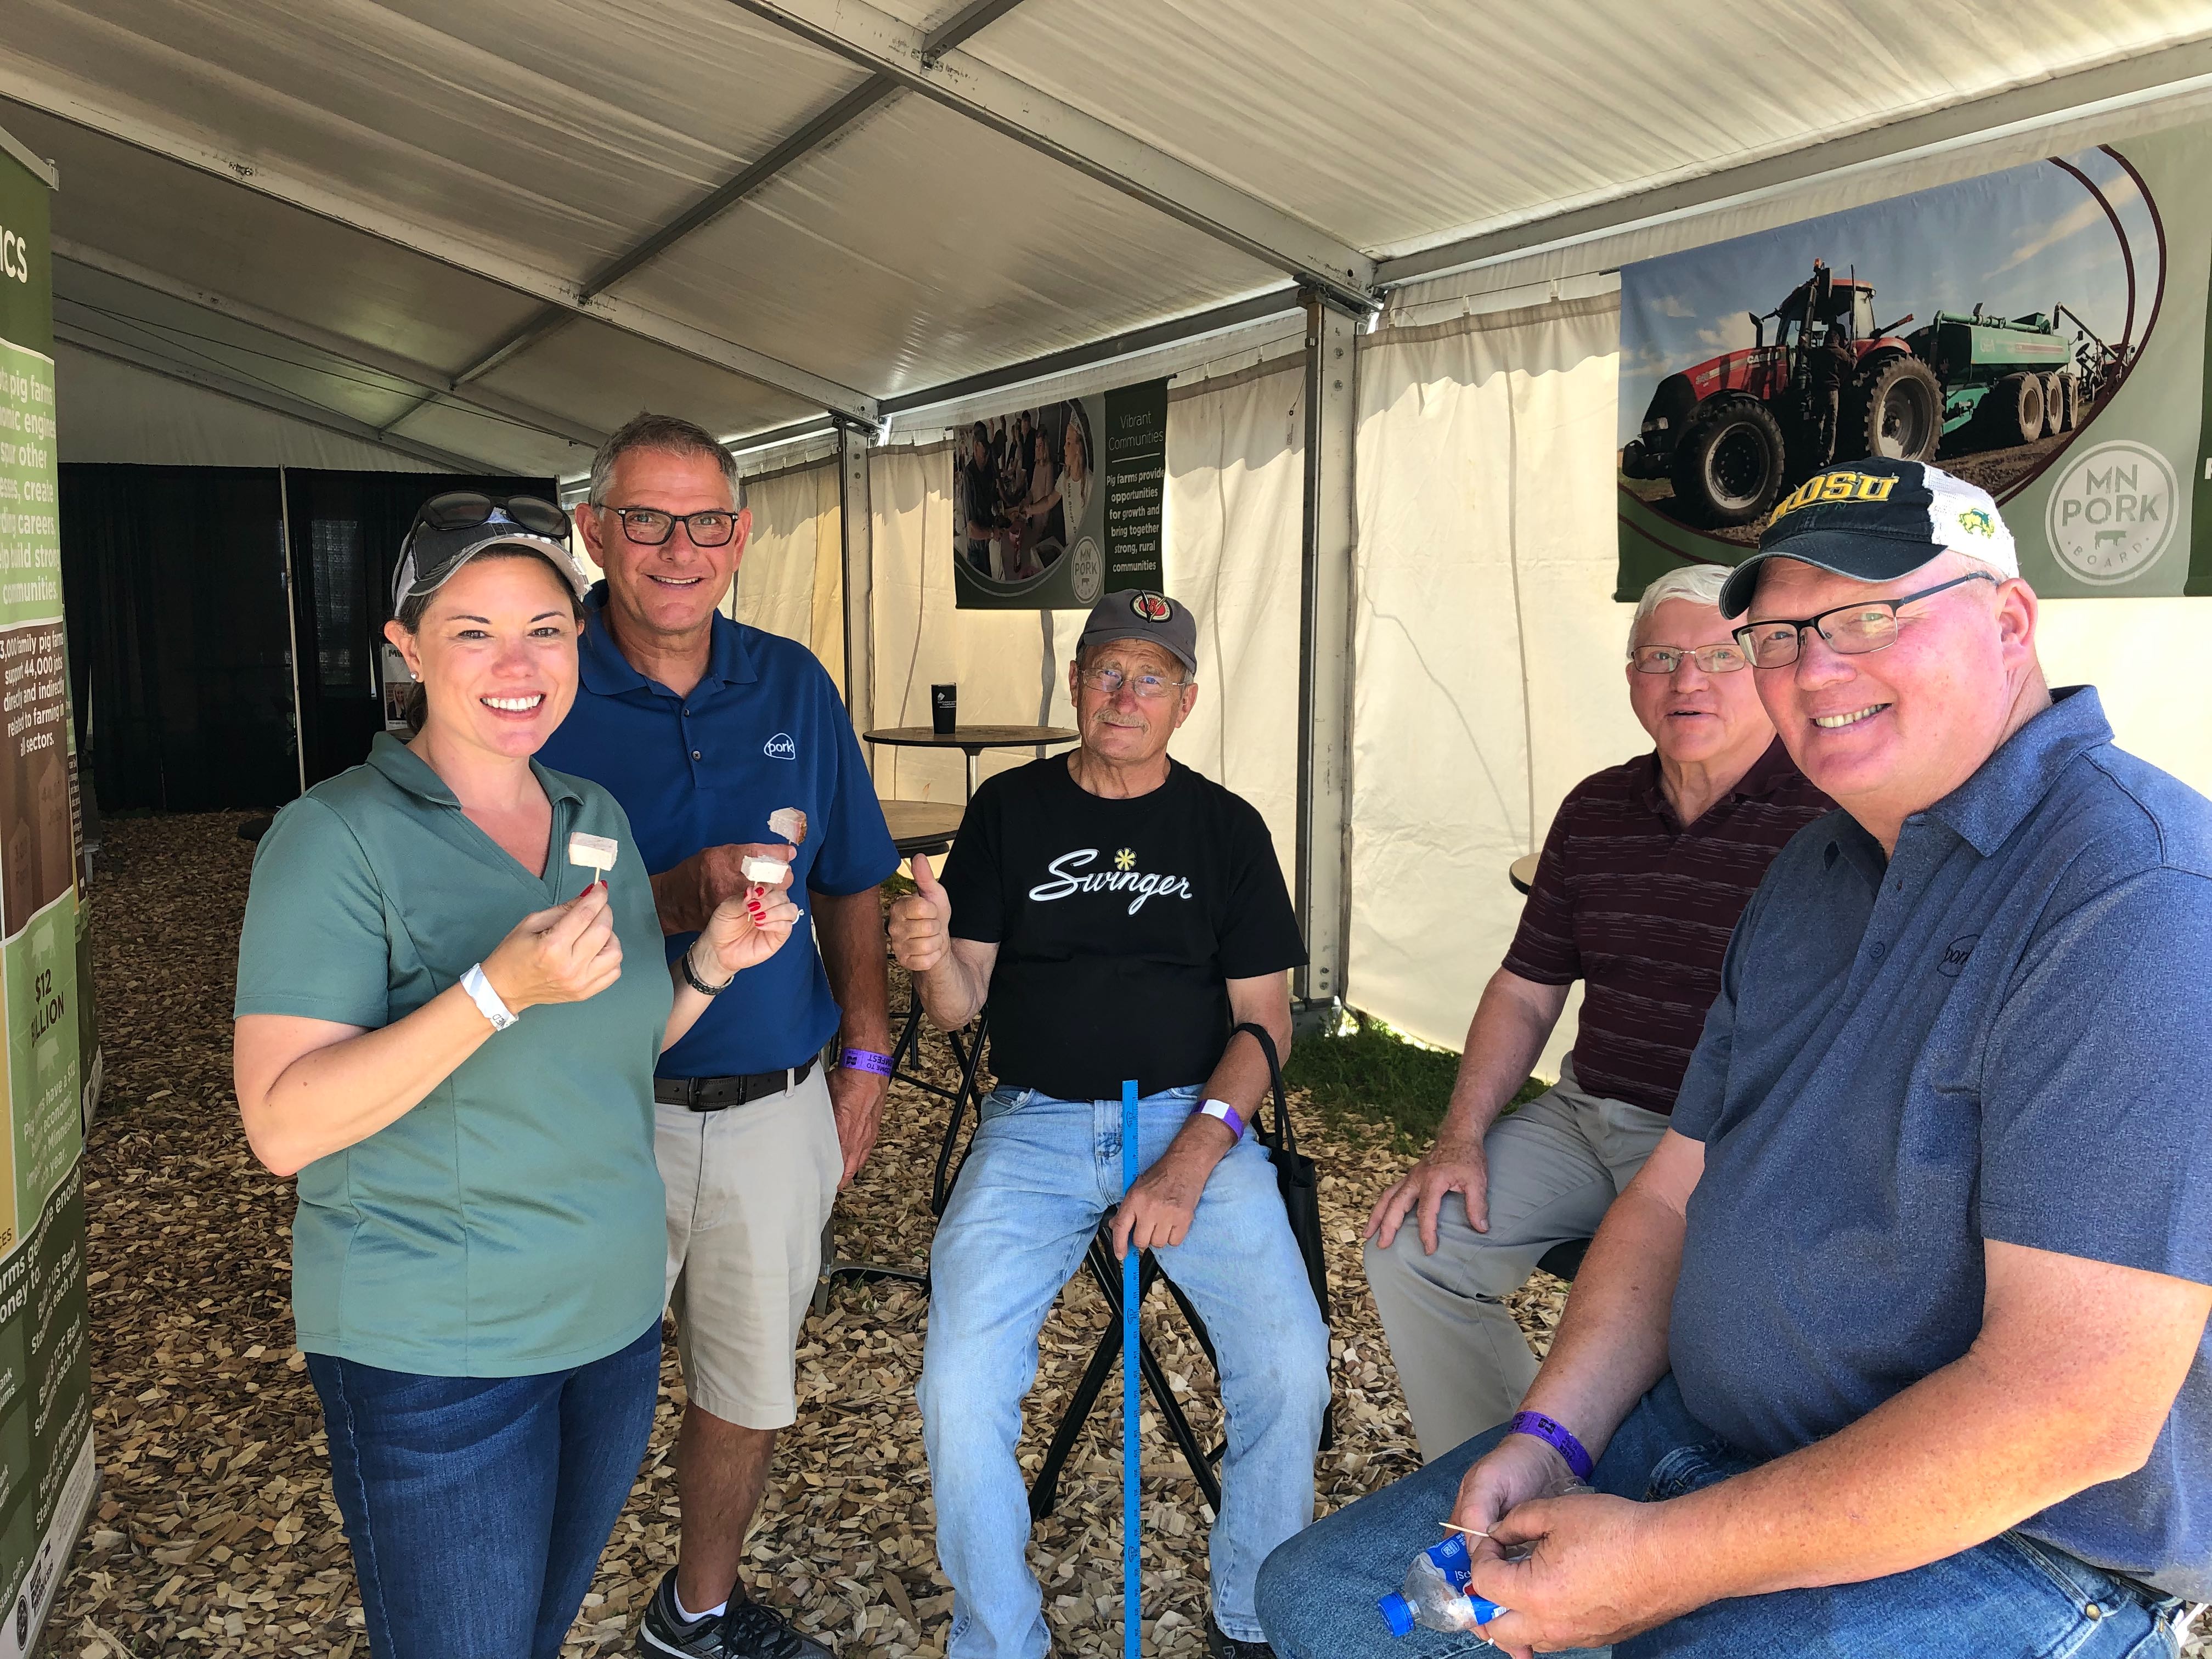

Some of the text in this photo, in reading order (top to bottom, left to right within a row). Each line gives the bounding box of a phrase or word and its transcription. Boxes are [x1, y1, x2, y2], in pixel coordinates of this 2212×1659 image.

[10, 370, 27, 403] pig
[30, 375, 53, 405] farms
[1120, 410, 1152, 429] Vibrant
[1108, 429, 1164, 450] Communities
[19, 442, 47, 469] other
[24, 481, 53, 503] create
[1107, 467, 1165, 487] Pig farms provide
[2086, 464, 2138, 495] MN
[1111, 486, 1158, 504] opportunities
[1109, 503, 1160, 520] for growth and
[2062, 495, 2159, 527] PORK
[1111, 522, 1159, 538] bring together
[1080, 548, 1091, 561] MN
[1114, 540, 1155, 555] strong, rural
[2073, 543, 2142, 568] BOARD
[1075, 561, 1098, 575] PORK
[1113, 559, 1156, 572] communities
[3, 575, 58, 604] communities.
[17, 633, 37, 655] family
[39, 631, 51, 654] pig
[52, 630, 63, 648] farms
[5, 653, 63, 687] support 44,000 jobs
[3, 675, 65, 712] directly and indirectly
[8, 712, 24, 738] related
[25, 712, 32, 729] to
[33, 702, 59, 726] farming
[60, 699, 64, 717] in
[26, 732, 54, 753] sectors.
[768, 740, 794, 755] pork
[1029, 848, 1193, 916] Swinger
[35, 968, 52, 1005] $12
[31, 991, 64, 1049] BILLION
[46, 1079, 63, 1106] have
[64, 1074, 67, 1088] a
[43, 1090, 72, 1133] economic
[48, 1107, 77, 1151] Minnesota
[49, 1147, 67, 1178] year.
[55, 1164, 81, 1214] enough
[52, 1262, 60, 1285] US
[61, 1239, 77, 1272] Bank
[53, 1276, 69, 1308] each
[70, 1256, 81, 1288] year.
[54, 1335, 66, 1365] TCF
[67, 1312, 81, 1346] Bank
[57, 1353, 72, 1386] each
[72, 1330, 84, 1364] year.
[58, 1392, 84, 1453] Minnesota
[63, 1432, 77, 1466] each
